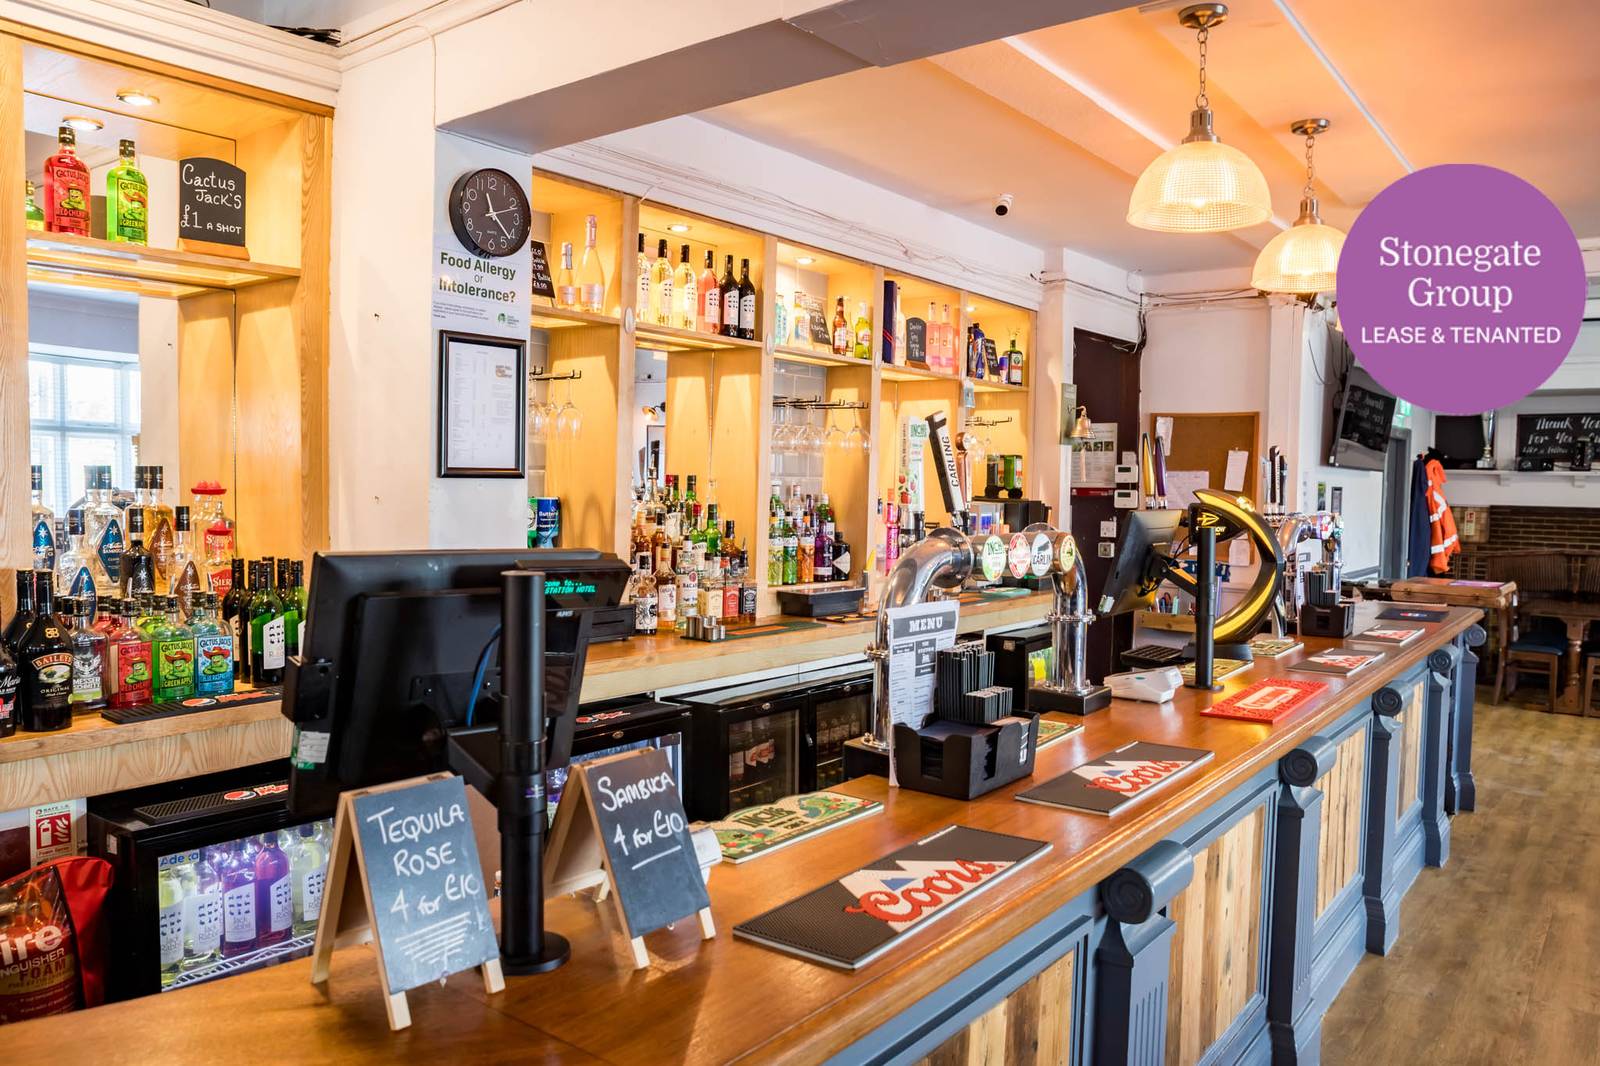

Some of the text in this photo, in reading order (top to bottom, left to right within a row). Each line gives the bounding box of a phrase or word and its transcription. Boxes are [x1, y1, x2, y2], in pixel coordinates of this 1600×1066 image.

[182, 163, 236, 192] Cactus
[476, 176, 484, 191] 11
[487, 177, 497, 190] 12
[466, 188, 477, 200] 10
[509, 197, 517, 209] 2
[463, 202, 471, 214] 9
[180, 205, 202, 229] £1
[216, 223, 242, 235] SHOT
[466, 218, 474, 231] 8
[513, 213, 520, 226] 3
[476, 231, 483, 243] 7
[488, 239, 496, 250] 6
[501, 236, 508, 249] 5
[440, 251, 472, 270] Food
[474, 259, 516, 280] Allergy
[439, 277, 516, 303] Intolerance?
[474, 275, 484, 284] or
[942, 436, 960, 488] CARLING
[545, 585, 596, 594] STATION HOTEL
[909, 616, 944, 633] MENU
[1084, 759, 1182, 793] Coors
[597, 772, 676, 812] SAMBUCA
[367, 803, 465, 845] TEQUILA
[613, 810, 684, 856] 4 for £10
[393, 841, 456, 877] ROSE
[844, 859, 1000, 923] Coors
[390, 889, 410, 922] 4
[418, 894, 443, 916] for
[0, 925, 62, 966] ire
